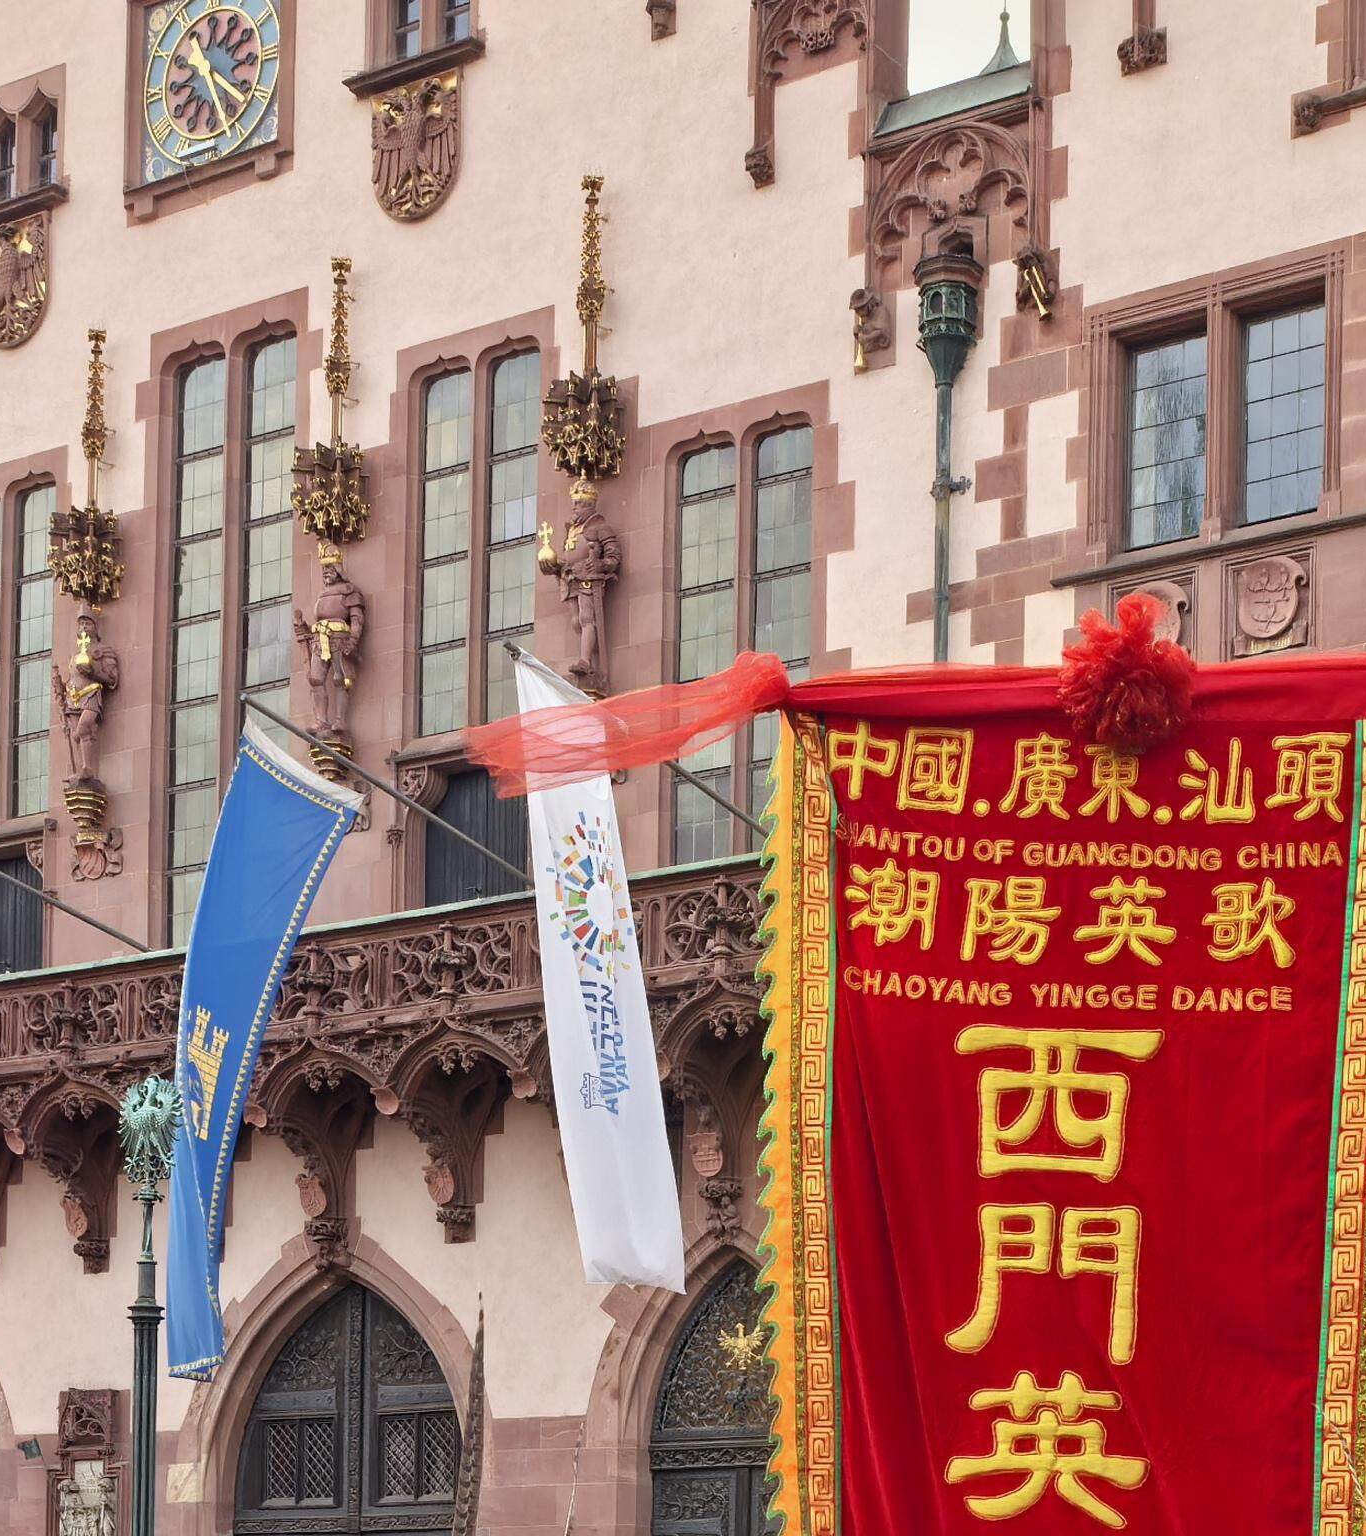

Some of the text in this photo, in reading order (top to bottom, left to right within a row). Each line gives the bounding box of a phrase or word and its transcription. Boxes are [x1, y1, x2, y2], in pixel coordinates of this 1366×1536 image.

[973, 839, 1014, 865] OF
[1022, 841, 1223, 872] GUANGDONG
[1237, 841, 1344, 870] CHINA
[844, 857, 1296, 969] 潮陽英歌
[843, 966, 1294, 1013] CHAOYANG YINGGE DANCE
